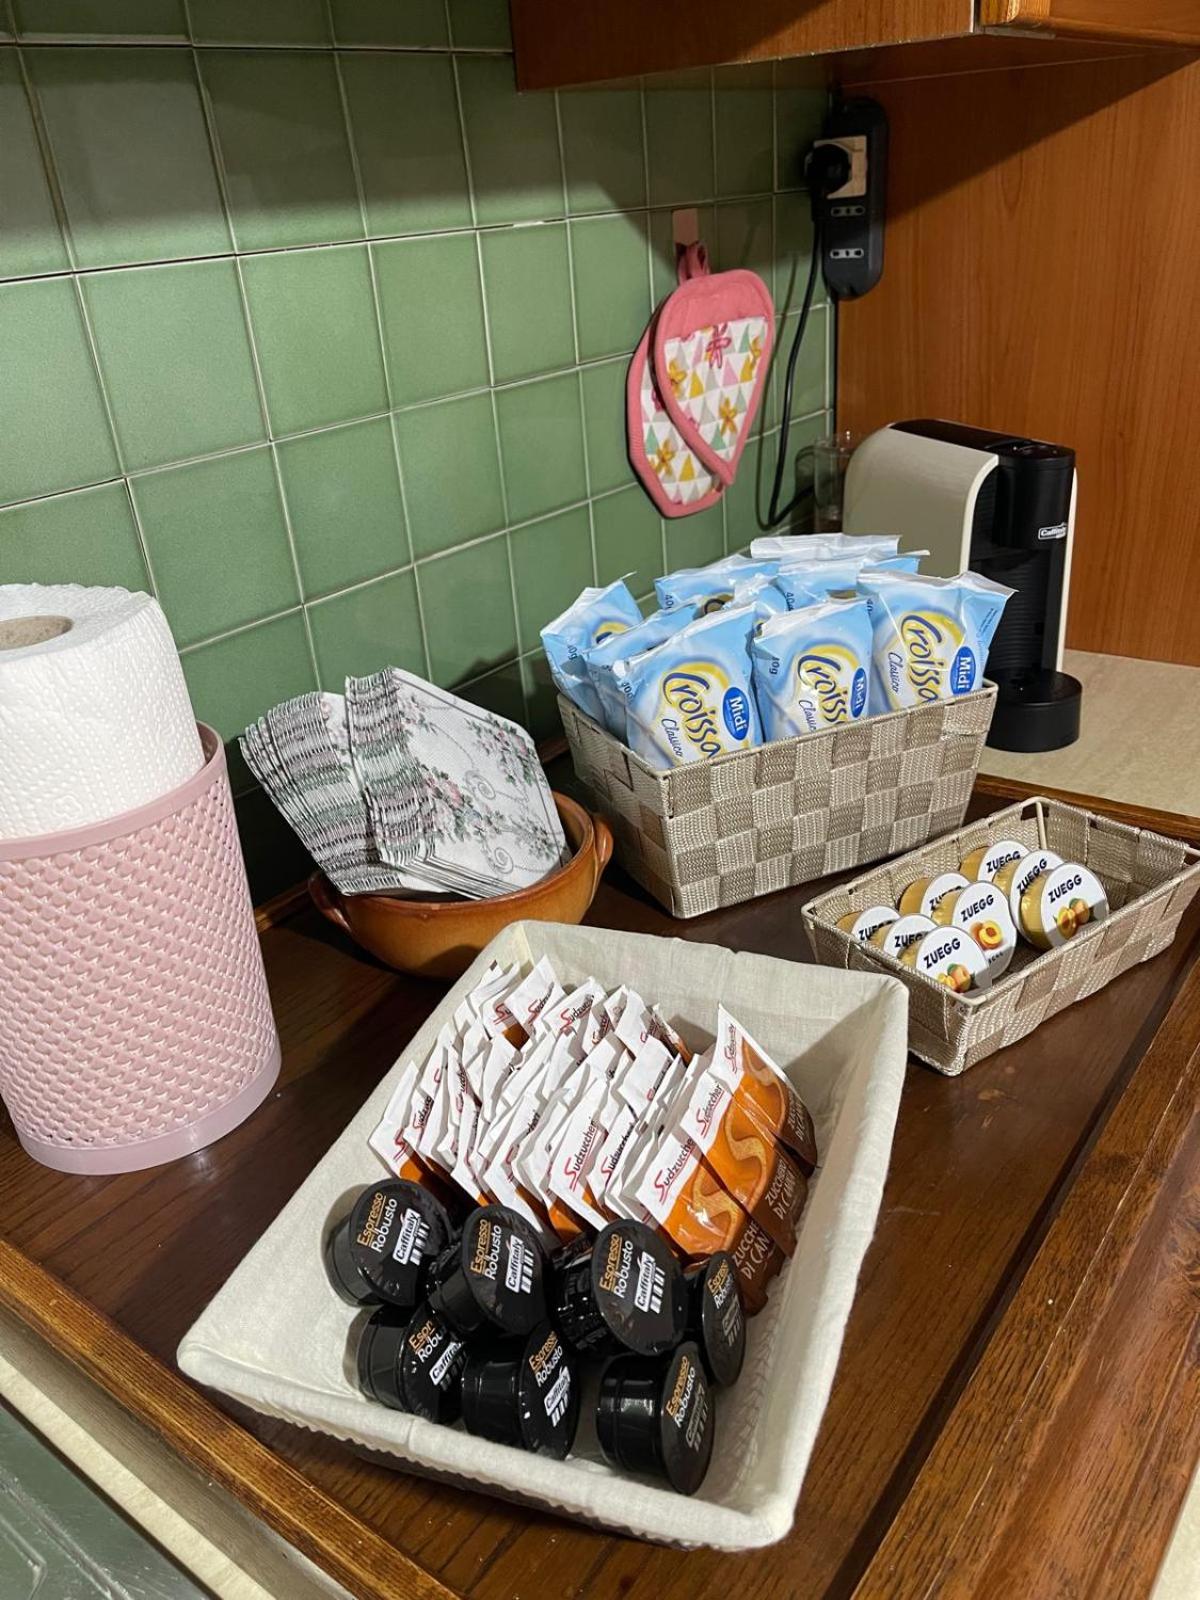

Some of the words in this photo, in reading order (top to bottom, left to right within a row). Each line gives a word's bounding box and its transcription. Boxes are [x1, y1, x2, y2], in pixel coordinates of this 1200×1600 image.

[797, 654, 849, 725] Croiss
[956, 656, 972, 690] Midi
[728, 695, 749, 732] Midi
[1017, 858, 1048, 895] ZUEGG
[1048, 874, 1082, 903] ZUEGG
[960, 894, 994, 922] ZUEGG
[923, 937, 961, 969] ZUEGG
[357, 1192, 383, 1247] Espresso
[371, 1198, 398, 1253] Robusto
[395, 1211, 418, 1260] Caffitaly
[470, 1219, 489, 1276] Espresso
[484, 1225, 502, 1280] Robusto
[507, 1239, 522, 1289] Caffitaly
[599, 1233, 621, 1292] Espresso
[613, 1240, 634, 1299] Robusto
[741, 1261, 756, 1280] DI
[636, 1257, 653, 1307] Caffitaly
[535, 1345, 563, 1388] Robusto
[665, 1355, 689, 1417] Espresso
[674, 1366, 696, 1428] Robusto
